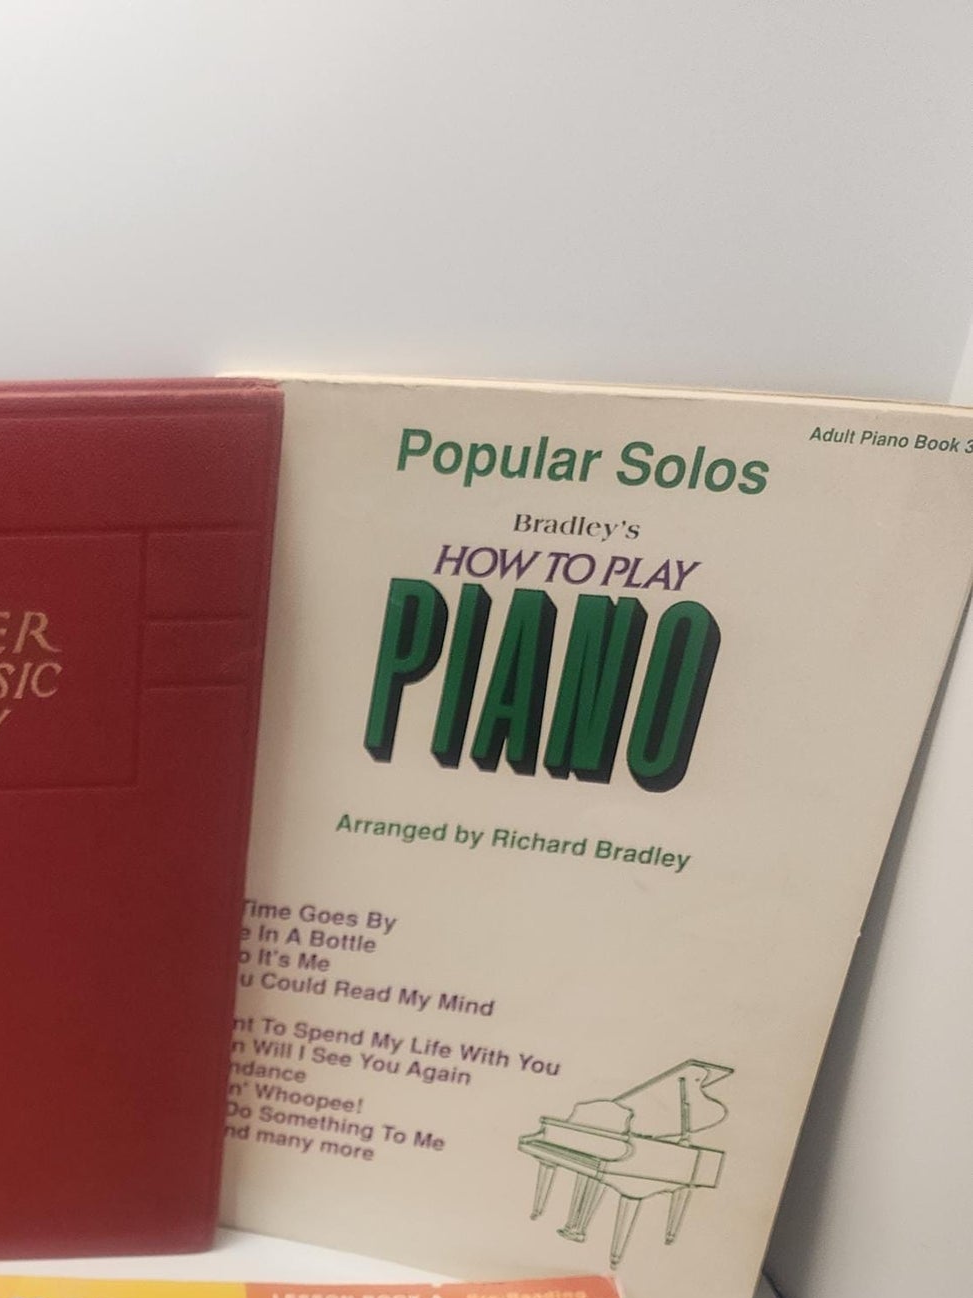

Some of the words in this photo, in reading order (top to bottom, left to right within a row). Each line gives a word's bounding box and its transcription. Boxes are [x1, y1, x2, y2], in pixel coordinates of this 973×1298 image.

[809, 426, 856, 445] Adult
[860, 430, 909, 448] Piano
[914, 434, 961, 452] Book
[397, 428, 602, 487] Popular
[616, 441, 770, 495] Solos
[513, 513, 641, 541] Bradley's
[433, 544, 541, 581] HOW
[543, 550, 597, 586] TO
[600, 556, 702, 592] PLAY
[364, 577, 721, 793] PIANO
[336, 813, 448, 843] Arranged
[454, 825, 484, 849] by
[491, 829, 588, 857] Richard
[594, 840, 691, 873] Bradley
[243, 899, 291, 920] Time
[299, 905, 358, 927] Goes
[366, 911, 397, 935] By
[258, 925, 278, 943] In
[285, 927, 301, 945] A
[309, 930, 377, 954] Bottle
[258, 948, 290, 968] It's
[298, 952, 330, 972] Me
[261, 973, 327, 995] Could
[334, 980, 391, 1003] Read
[398, 987, 431, 1012] My
[437, 992, 495, 1016] Mind
[253, 1040, 293, 1058] Will
[298, 1045, 305, 1061] I
[311, 1047, 352, 1067] See
[360, 1053, 401, 1074] You
[405, 1061, 472, 1086] Again
[262, 1018, 286, 1036] To
[293, 1022, 364, 1046] Spend
[371, 1031, 404, 1055] My
[410, 1037, 452, 1058] Life
[460, 1043, 510, 1068] With
[518, 1053, 561, 1076] You
[230, 1061, 306, 1083] ndance
[255, 1083, 364, 1113] Whoopee!
[224, 1125, 249, 1140] nd
[256, 1129, 314, 1153] many
[320, 1141, 375, 1161] more
[259, 1105, 374, 1141] Something
[382, 1125, 406, 1145] To
[413, 1130, 446, 1151] Me
